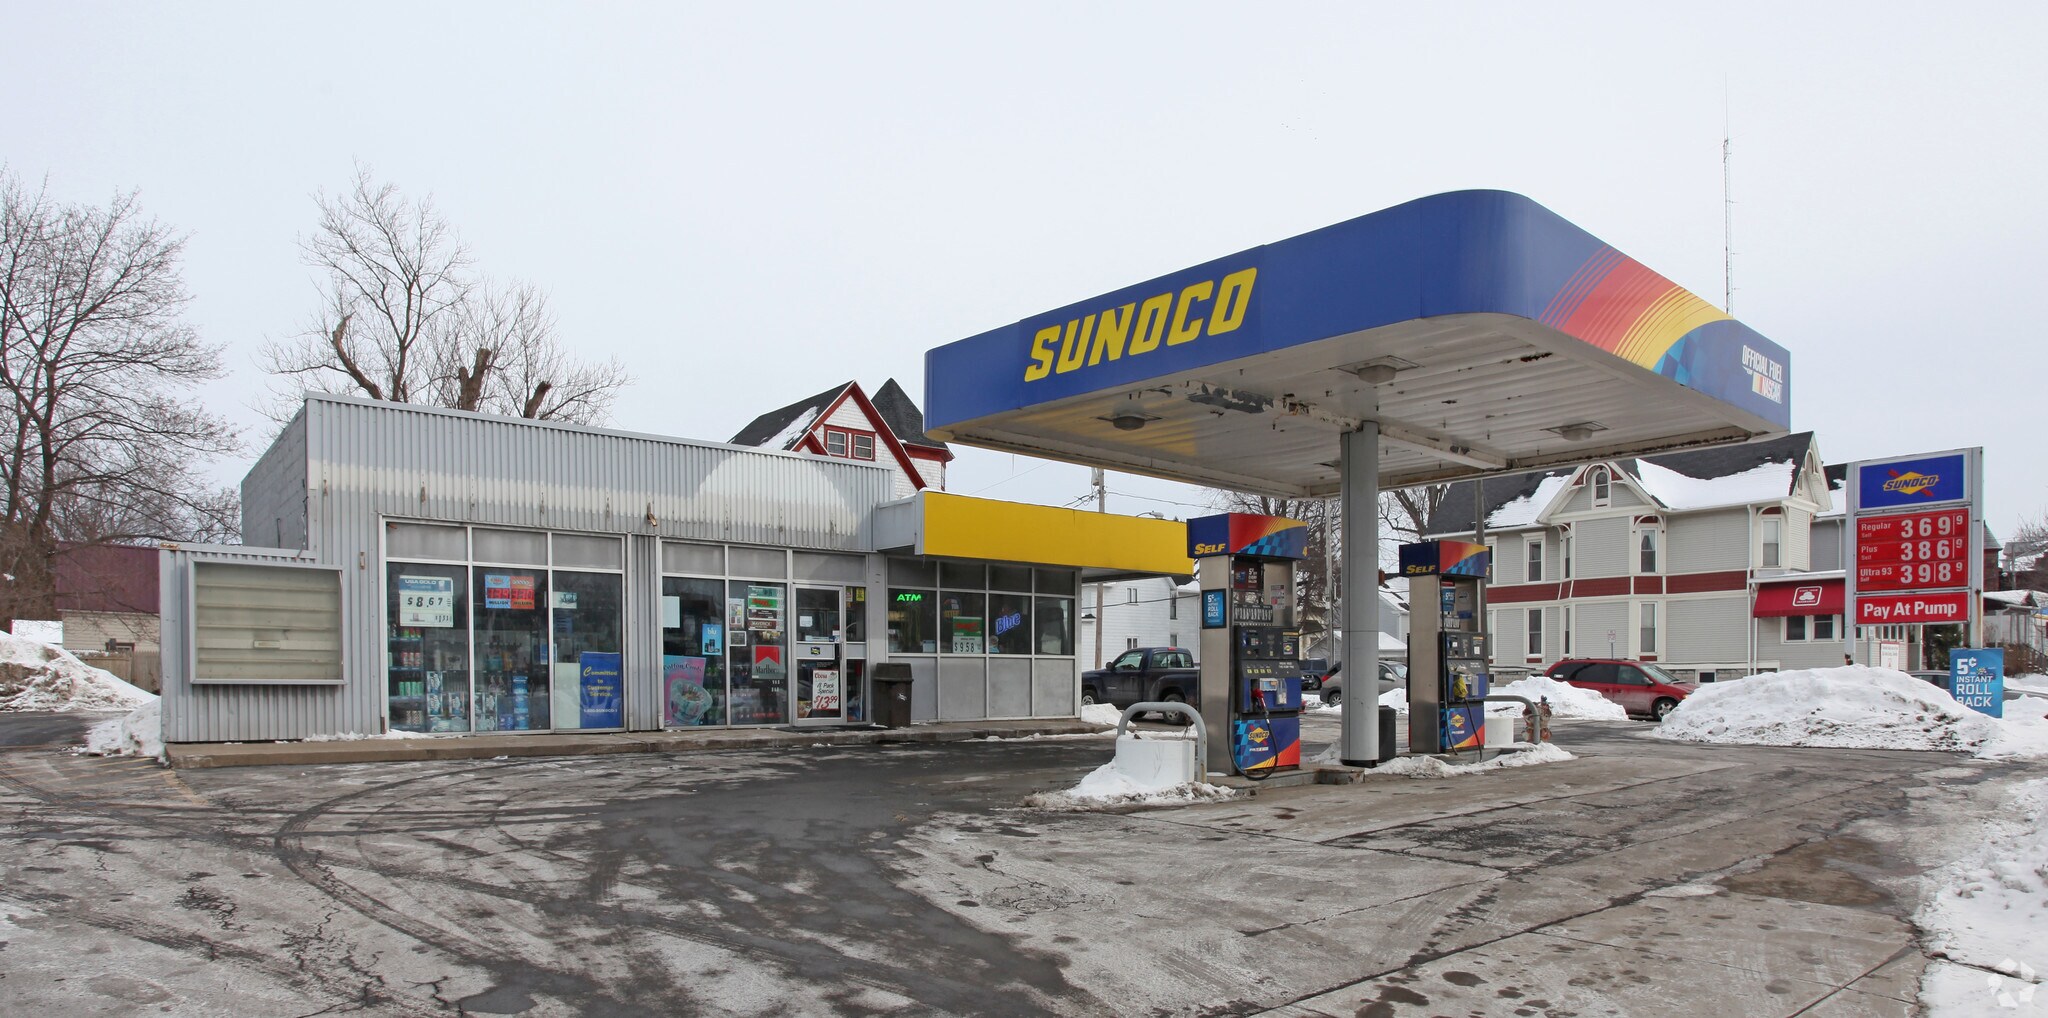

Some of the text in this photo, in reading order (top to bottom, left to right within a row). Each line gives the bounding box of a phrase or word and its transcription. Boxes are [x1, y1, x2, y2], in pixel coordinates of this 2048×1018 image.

[1024, 267, 1257, 383] SUNOCO
[1742, 344, 1783, 384] OFFICIAL FUEL
[1762, 377, 1783, 404] NASCAR
[1885, 475, 1938, 490] SUNOCO
[1861, 522, 1891, 531] Regular
[1194, 543, 1226, 555] SELF
[1302, 546, 1308, 556] 4
[1406, 565, 1436, 574] SELF
[1485, 568, 1490, 576] 2
[1860, 568, 1880, 576] Ultra
[1881, 567, 1892, 575] 93
[896, 593, 922, 601] ATM
[1863, 601, 1957, 620] Pay At Pump
[995, 612, 1021, 635] Blue
[707, 627, 717, 635] blu
[583, 666, 618, 676] Committed
[663, 662, 684, 671] Cotton
[1956, 657, 1977, 675] 5¢
[1956, 675, 1994, 683] INSTANT
[1956, 683, 1992, 695] ROLL
[1956, 696, 1992, 707] BACK
[1249, 730, 1269, 740] SUNOCO
